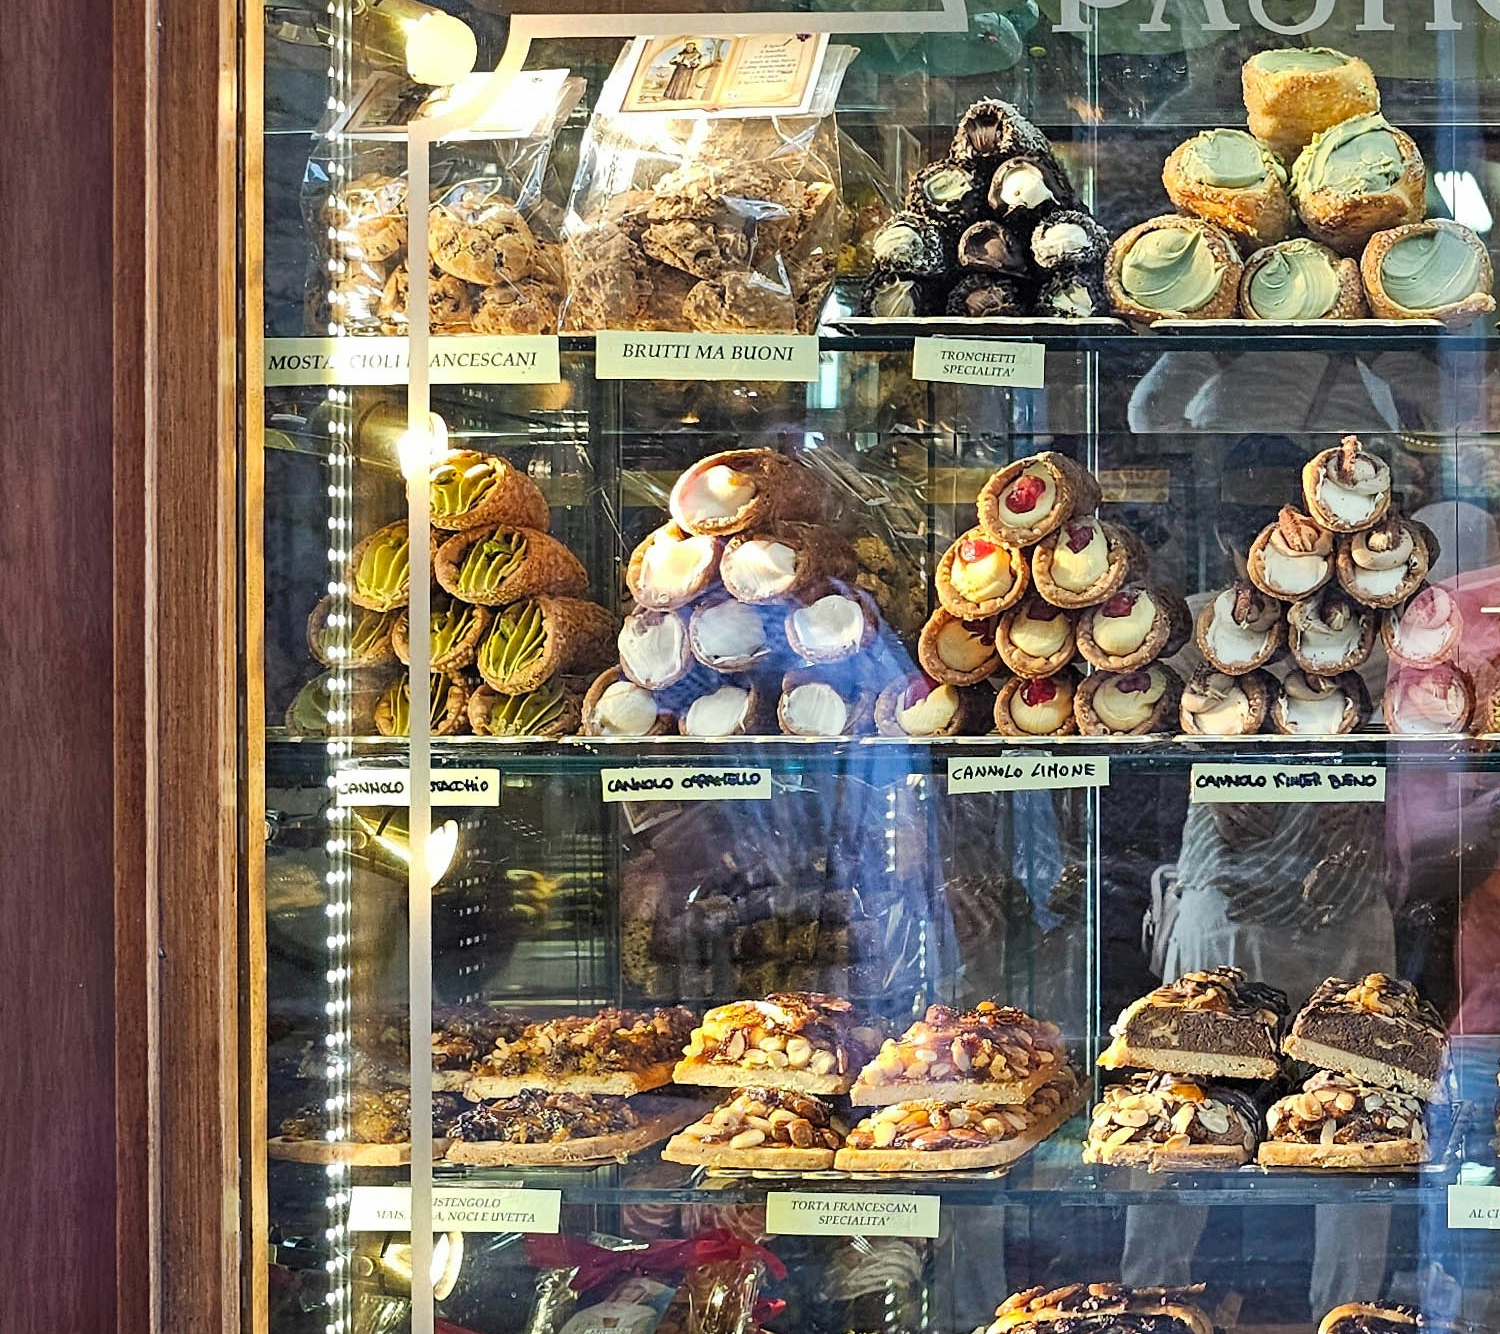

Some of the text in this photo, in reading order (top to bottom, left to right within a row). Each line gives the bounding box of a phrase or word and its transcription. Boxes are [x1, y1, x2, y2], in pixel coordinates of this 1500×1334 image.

[622, 342, 795, 362] BRUTTI MA BUONI
[940, 350, 1016, 364] TRONCHETTI
[942, 364, 1015, 378] SPECIALITA'
[952, 762, 1096, 780] CANNOLO LIMONE
[337, 780, 404, 795] CANNOLO
[607, 777, 674, 793] CANNOLO
[1195, 773, 1267, 789] CANNOLO
[791, 1200, 918, 1214] TORTA FRANCESCANA
[1469, 1208, 1485, 1219] AL
[447, 1210, 481, 1222] NOCI
[481, 1212, 490, 1222] E
[490, 1212, 536, 1223] UVETTA
[818, 1215, 890, 1227] SPECIALITA'
